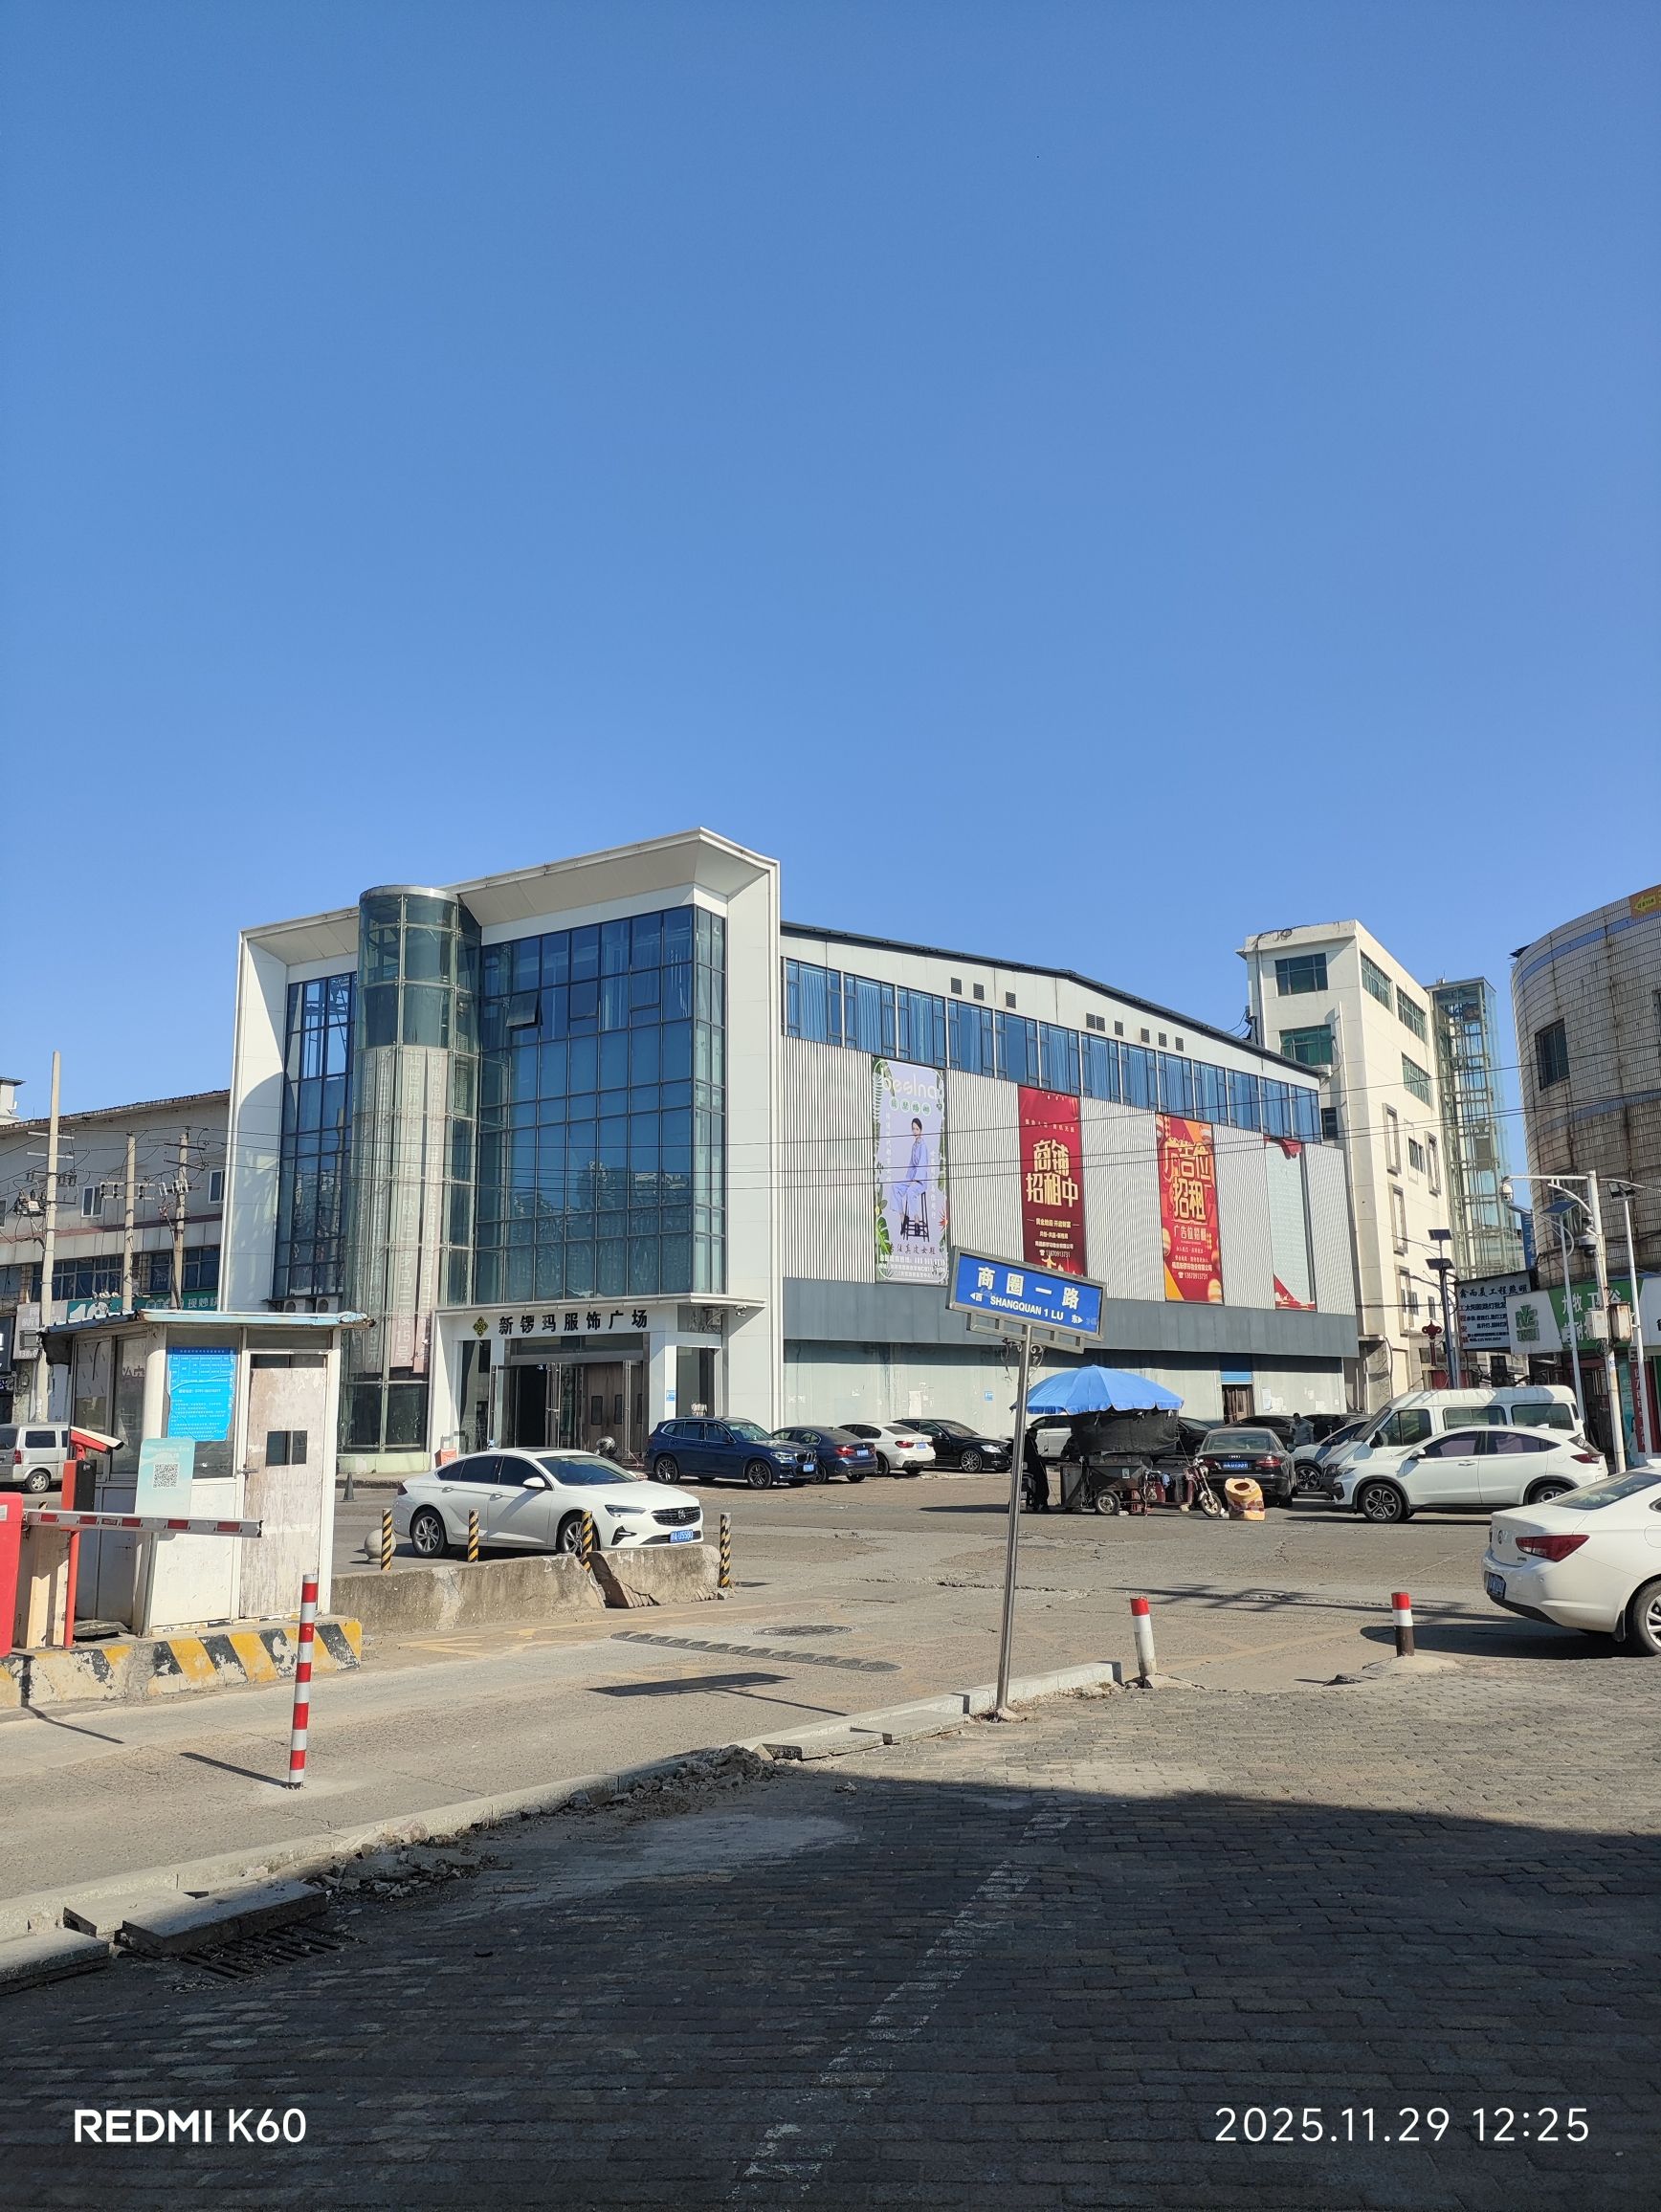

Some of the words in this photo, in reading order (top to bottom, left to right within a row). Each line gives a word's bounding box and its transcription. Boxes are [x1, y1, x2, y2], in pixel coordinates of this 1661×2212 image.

[1032, 1139, 1070, 1177] 商铺
[1163, 1141, 1211, 1180] 广告位
[1025, 1172, 1079, 1207] 招租中
[1172, 1178, 1207, 1221] 招租
[974, 1293, 983, 1302] 西
[977, 1266, 1080, 1310] 商圈一路
[498, 1309, 648, 1335] 新锣玛服饰广场
[989, 1295, 1042, 1316] SHANGQUAN
[1043, 1308, 1049, 1317] 1
[1051, 1310, 1064, 1320] LU
[1071, 1314, 1078, 1324] 东
